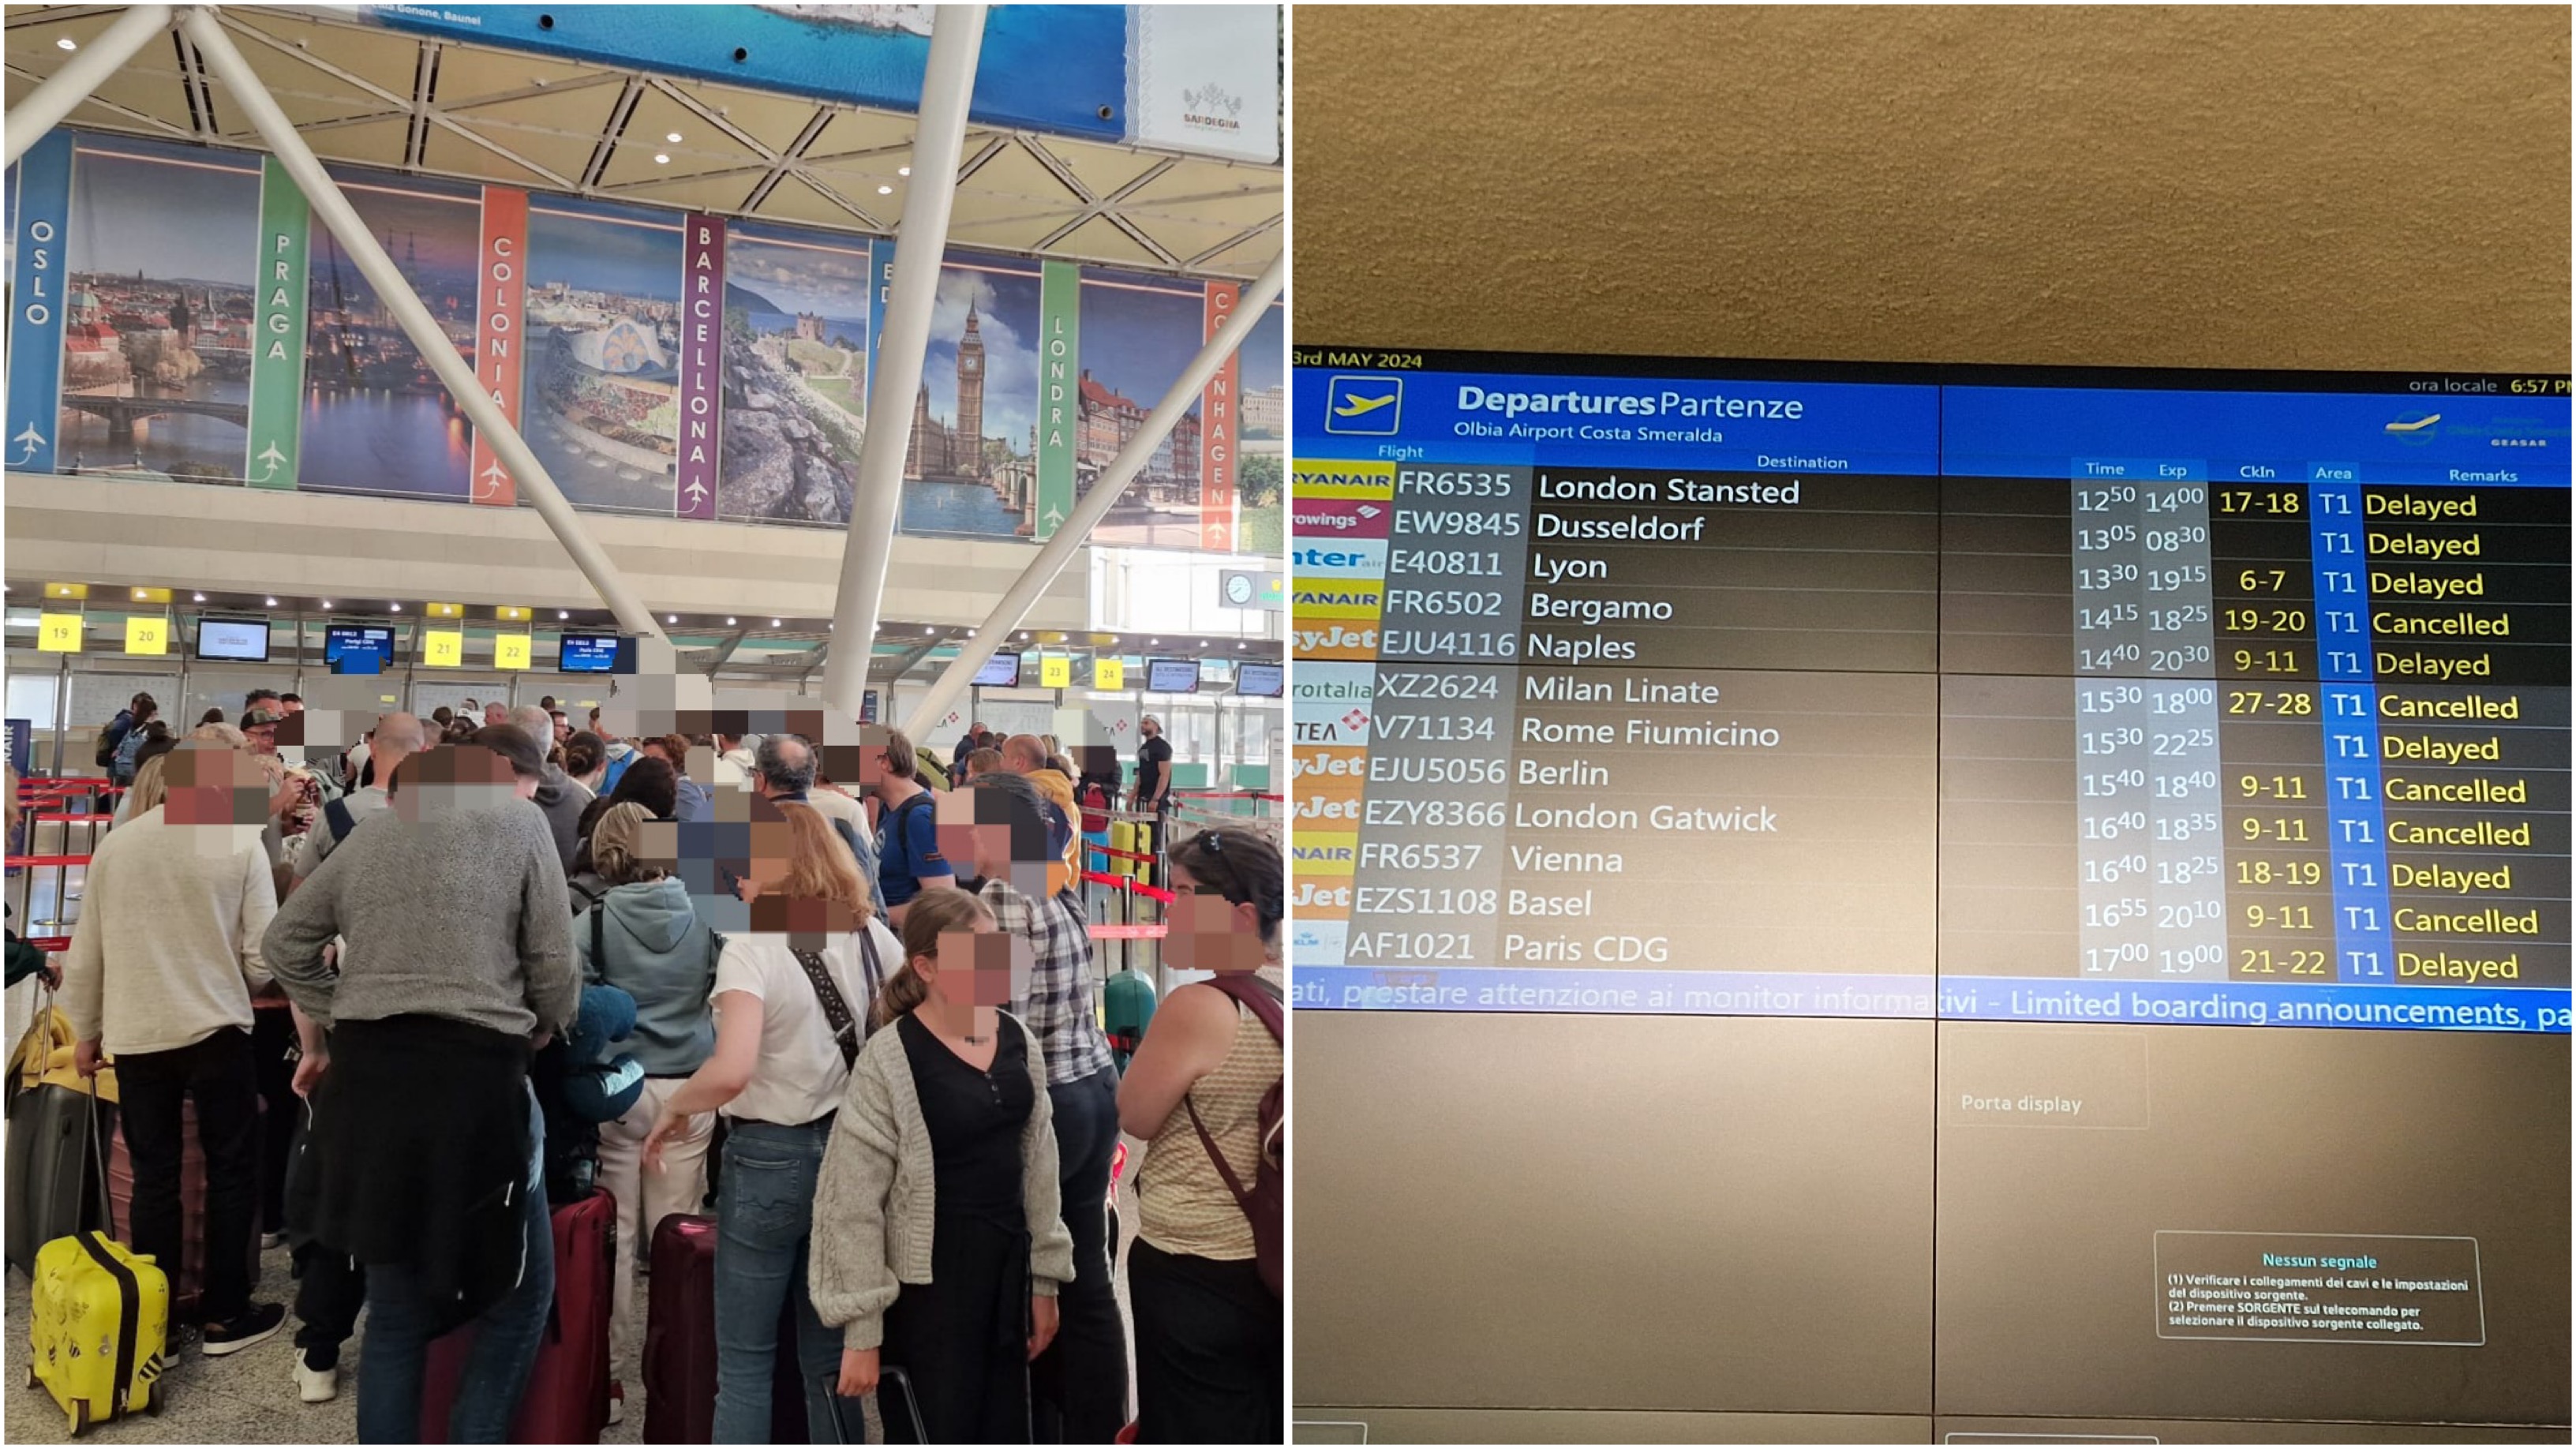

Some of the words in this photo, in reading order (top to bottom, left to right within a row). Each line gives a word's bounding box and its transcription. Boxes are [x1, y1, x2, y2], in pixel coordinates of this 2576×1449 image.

[1184, 113, 1240, 129] SARDEGNA
[25, 221, 54, 325] OSLO
[266, 234, 290, 361] PRAGA
[489, 237, 514, 410] COLONIA
[689, 227, 713, 464] BARCELLONA
[1328, 352, 1372, 366] MAY
[1377, 354, 1422, 368] 2024
[1048, 318, 1066, 447] LONDRA
[1458, 386, 1655, 417] Departures
[1661, 391, 1803, 420] Partenze
[2409, 381, 2438, 391] ora
[2445, 379, 2497, 392] locale
[2511, 380, 2548, 393] 6:57
[1454, 421, 1503, 438] Olbia
[1509, 423, 1574, 441] Airport
[1579, 426, 1632, 440] Costa
[1637, 426, 1722, 444] Smeralda
[1378, 444, 1424, 461] Flight
[1758, 455, 1848, 470] Destination
[2087, 462, 2124, 476] Time
[2159, 464, 2186, 479] Exp
[2316, 466, 2351, 480] Area
[2450, 470, 2518, 482] Remarks
[1398, 473, 1511, 496] FR6535
[1539, 475, 1657, 501] London
[1668, 478, 1799, 504] Stansted
[2220, 492, 2299, 515] 17-18
[2319, 493, 2351, 515] T1
[2366, 493, 2477, 522] Delayed
[1395, 511, 1521, 536] EW9845
[1537, 515, 1705, 541] Dusseldorf
[2320, 531, 2353, 553] T1
[2368, 533, 2480, 560] Delayed
[1390, 551, 1503, 576] E40811
[1533, 554, 1607, 583] Lyon
[2239, 570, 2286, 591] 6-7
[2323, 571, 2356, 593] T1
[2371, 572, 2484, 600] Delayed
[53, 627, 69, 640] 19
[1386, 590, 1502, 615] FR6502
[1530, 594, 1673, 625] Bergamo
[2225, 609, 2305, 632] 19-20
[2326, 611, 2359, 633] T1
[2372, 612, 2509, 636] Cancelled
[138, 629, 154, 643] 20
[436, 642, 451, 656] 21
[505, 646, 520, 659] 22
[1381, 630, 1515, 657] EJU4116
[1527, 634, 1636, 663] Naples
[2234, 650, 2298, 672] 9-11
[2328, 651, 2362, 673] T1
[2376, 653, 2490, 682] Delayed
[1050, 667, 1061, 677] 23
[1103, 668, 1114, 679] 24
[1376, 674, 1498, 699] XZ2624
[1525, 676, 1612, 703] Milan
[1624, 680, 1719, 705] Linate
[2229, 692, 2312, 714] 27-28
[2331, 694, 2364, 716] T1
[2379, 695, 2519, 720] Cancelled
[1373, 716, 1495, 741] V71134
[1522, 719, 1614, 743] Rome
[1626, 720, 1779, 747] Fiumicino
[2334, 735, 2368, 758] T1
[2383, 736, 2499, 765] Delayed
[1369, 757, 1506, 784] EJU5056
[1518, 758, 1608, 786] Berlin
[2241, 777, 2307, 799] 9-11
[2337, 777, 2370, 799] T1
[2385, 778, 2525, 804] Cancelled
[1365, 799, 1506, 827] EZY8366
[1515, 802, 1638, 829] London
[1650, 805, 1777, 831] Gatwick
[2242, 819, 2308, 841] 9-11
[2338, 820, 2373, 842] T1
[2387, 821, 2529, 847] Cancelled
[1360, 843, 1481, 870] FR6537
[1511, 846, 1623, 872] Vienna
[2237, 861, 2321, 885] 18-19
[2342, 863, 2376, 886] T1
[2392, 865, 2510, 894] Delayed
[1356, 888, 1496, 915] EZS1108
[1509, 889, 1591, 915] Basel
[2246, 905, 2314, 928] 9-11
[2345, 908, 2379, 930] T1
[2394, 909, 2538, 934] Cancelled
[1349, 933, 1474, 959] AF1021
[1505, 934, 1582, 960] Paris
[1593, 937, 1668, 962] CDG
[2240, 950, 2325, 973] 21-22
[2347, 951, 2383, 975] T1
[2398, 953, 2519, 982] Delayed
[1344, 983, 1467, 1009] prestare
[1478, 981, 1637, 1012] attenzione
[1648, 983, 1672, 1008] ai
[1684, 984, 1803, 1010] monitor
[2012, 990, 2121, 1017] Limited
[2132, 992, 2267, 1024] boarding
[2277, 1000, 2525, 1028] announcements,
[1961, 1095, 2012, 1111] Porta
[2018, 1096, 2081, 1114] display
[2169, 1274, 2183, 1286] (1)
[2185, 1275, 2241, 1286] Verificare
[2250, 1276, 2323, 1290] collegamenti
[2326, 1277, 2343, 1288] dei
[2346, 1278, 2368, 1289] cavi
[2372, 1280, 2379, 1289] e
[2382, 1279, 2392, 1290] le
[2394, 1279, 2468, 1292] impostazioni
[2263, 1253, 2316, 1267] Nessun
[2320, 1255, 2377, 1271] segnale
[2169, 1288, 2186, 1298] del
[2189, 1288, 2251, 1300] dispositivo
[2254, 1291, 2308, 1302] sorgente.
[2169, 1301, 2184, 1312] (2)
[2186, 1301, 2234, 1312] Premere
[2237, 1303, 2301, 1314] SORGENTE
[2304, 1302, 2320, 1315] sul
[2323, 1304, 2398, 1316] telecomando
[2401, 1308, 2421, 1319] per
[2170, 1315, 2234, 1325] selezionare
[2237, 1316, 2244, 1326] il
[2247, 1316, 2309, 1328] dispositivo
[2312, 1319, 2363, 1331] sorgente
[2367, 1319, 2424, 1332] collegato.
